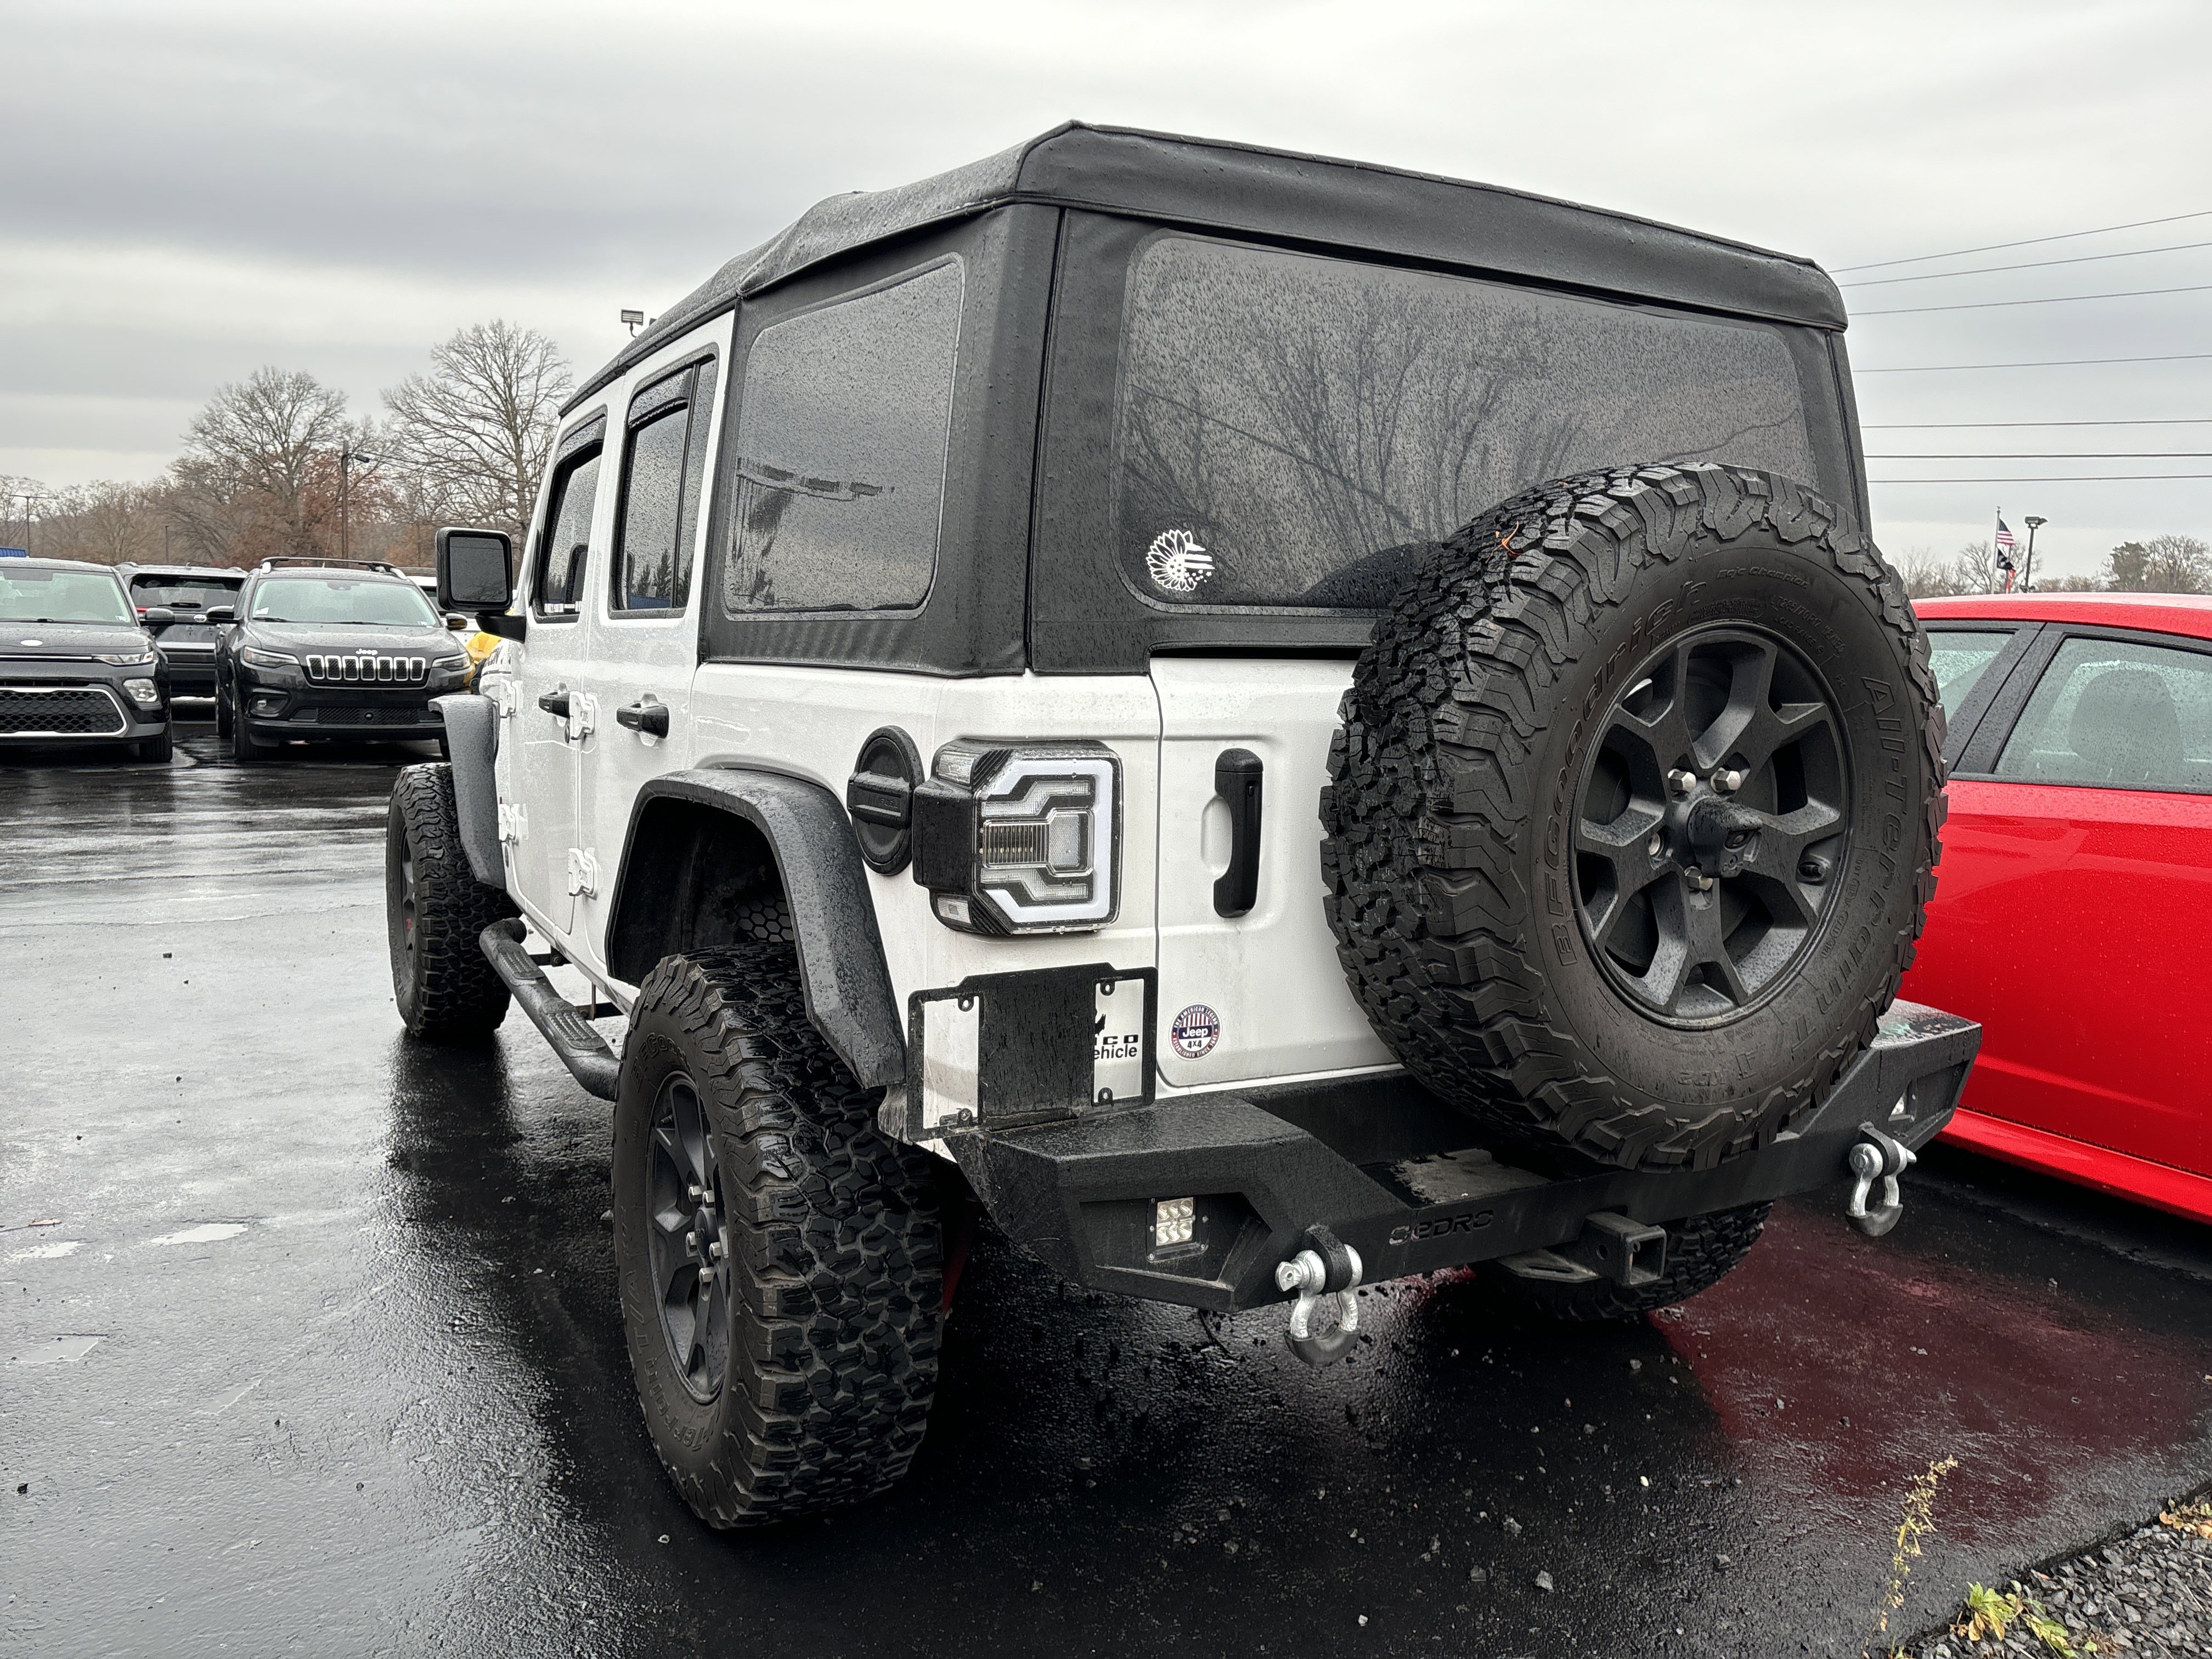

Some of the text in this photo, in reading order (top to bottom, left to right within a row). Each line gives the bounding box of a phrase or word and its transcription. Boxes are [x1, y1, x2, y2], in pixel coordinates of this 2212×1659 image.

[1544, 580, 1707, 967] BFGoodrich
[1173, 1007, 1218, 1028] THE AMERICAN LEGEND
[1182, 1027, 1209, 1038] Jeep
[1172, 1037, 1195, 1058] ESTABLISHED
[1197, 1046, 1211, 1057] SINCE
